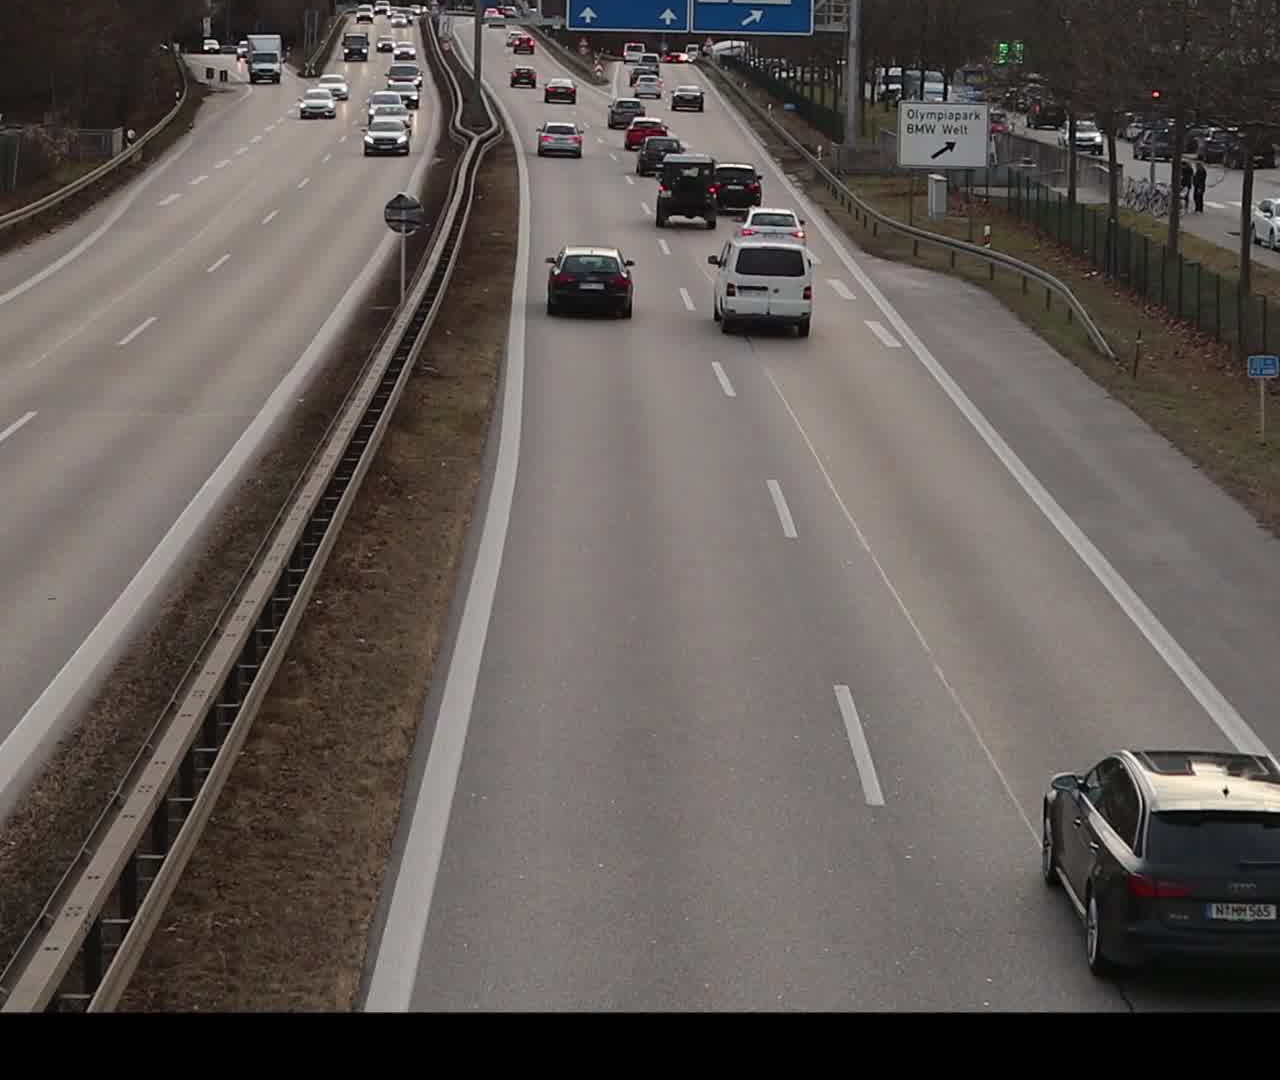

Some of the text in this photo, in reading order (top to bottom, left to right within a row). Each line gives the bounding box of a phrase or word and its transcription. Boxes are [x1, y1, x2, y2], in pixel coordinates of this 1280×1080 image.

[906, 109, 981, 123] Olympiapark
[906, 123, 968, 135] BMW Welt
